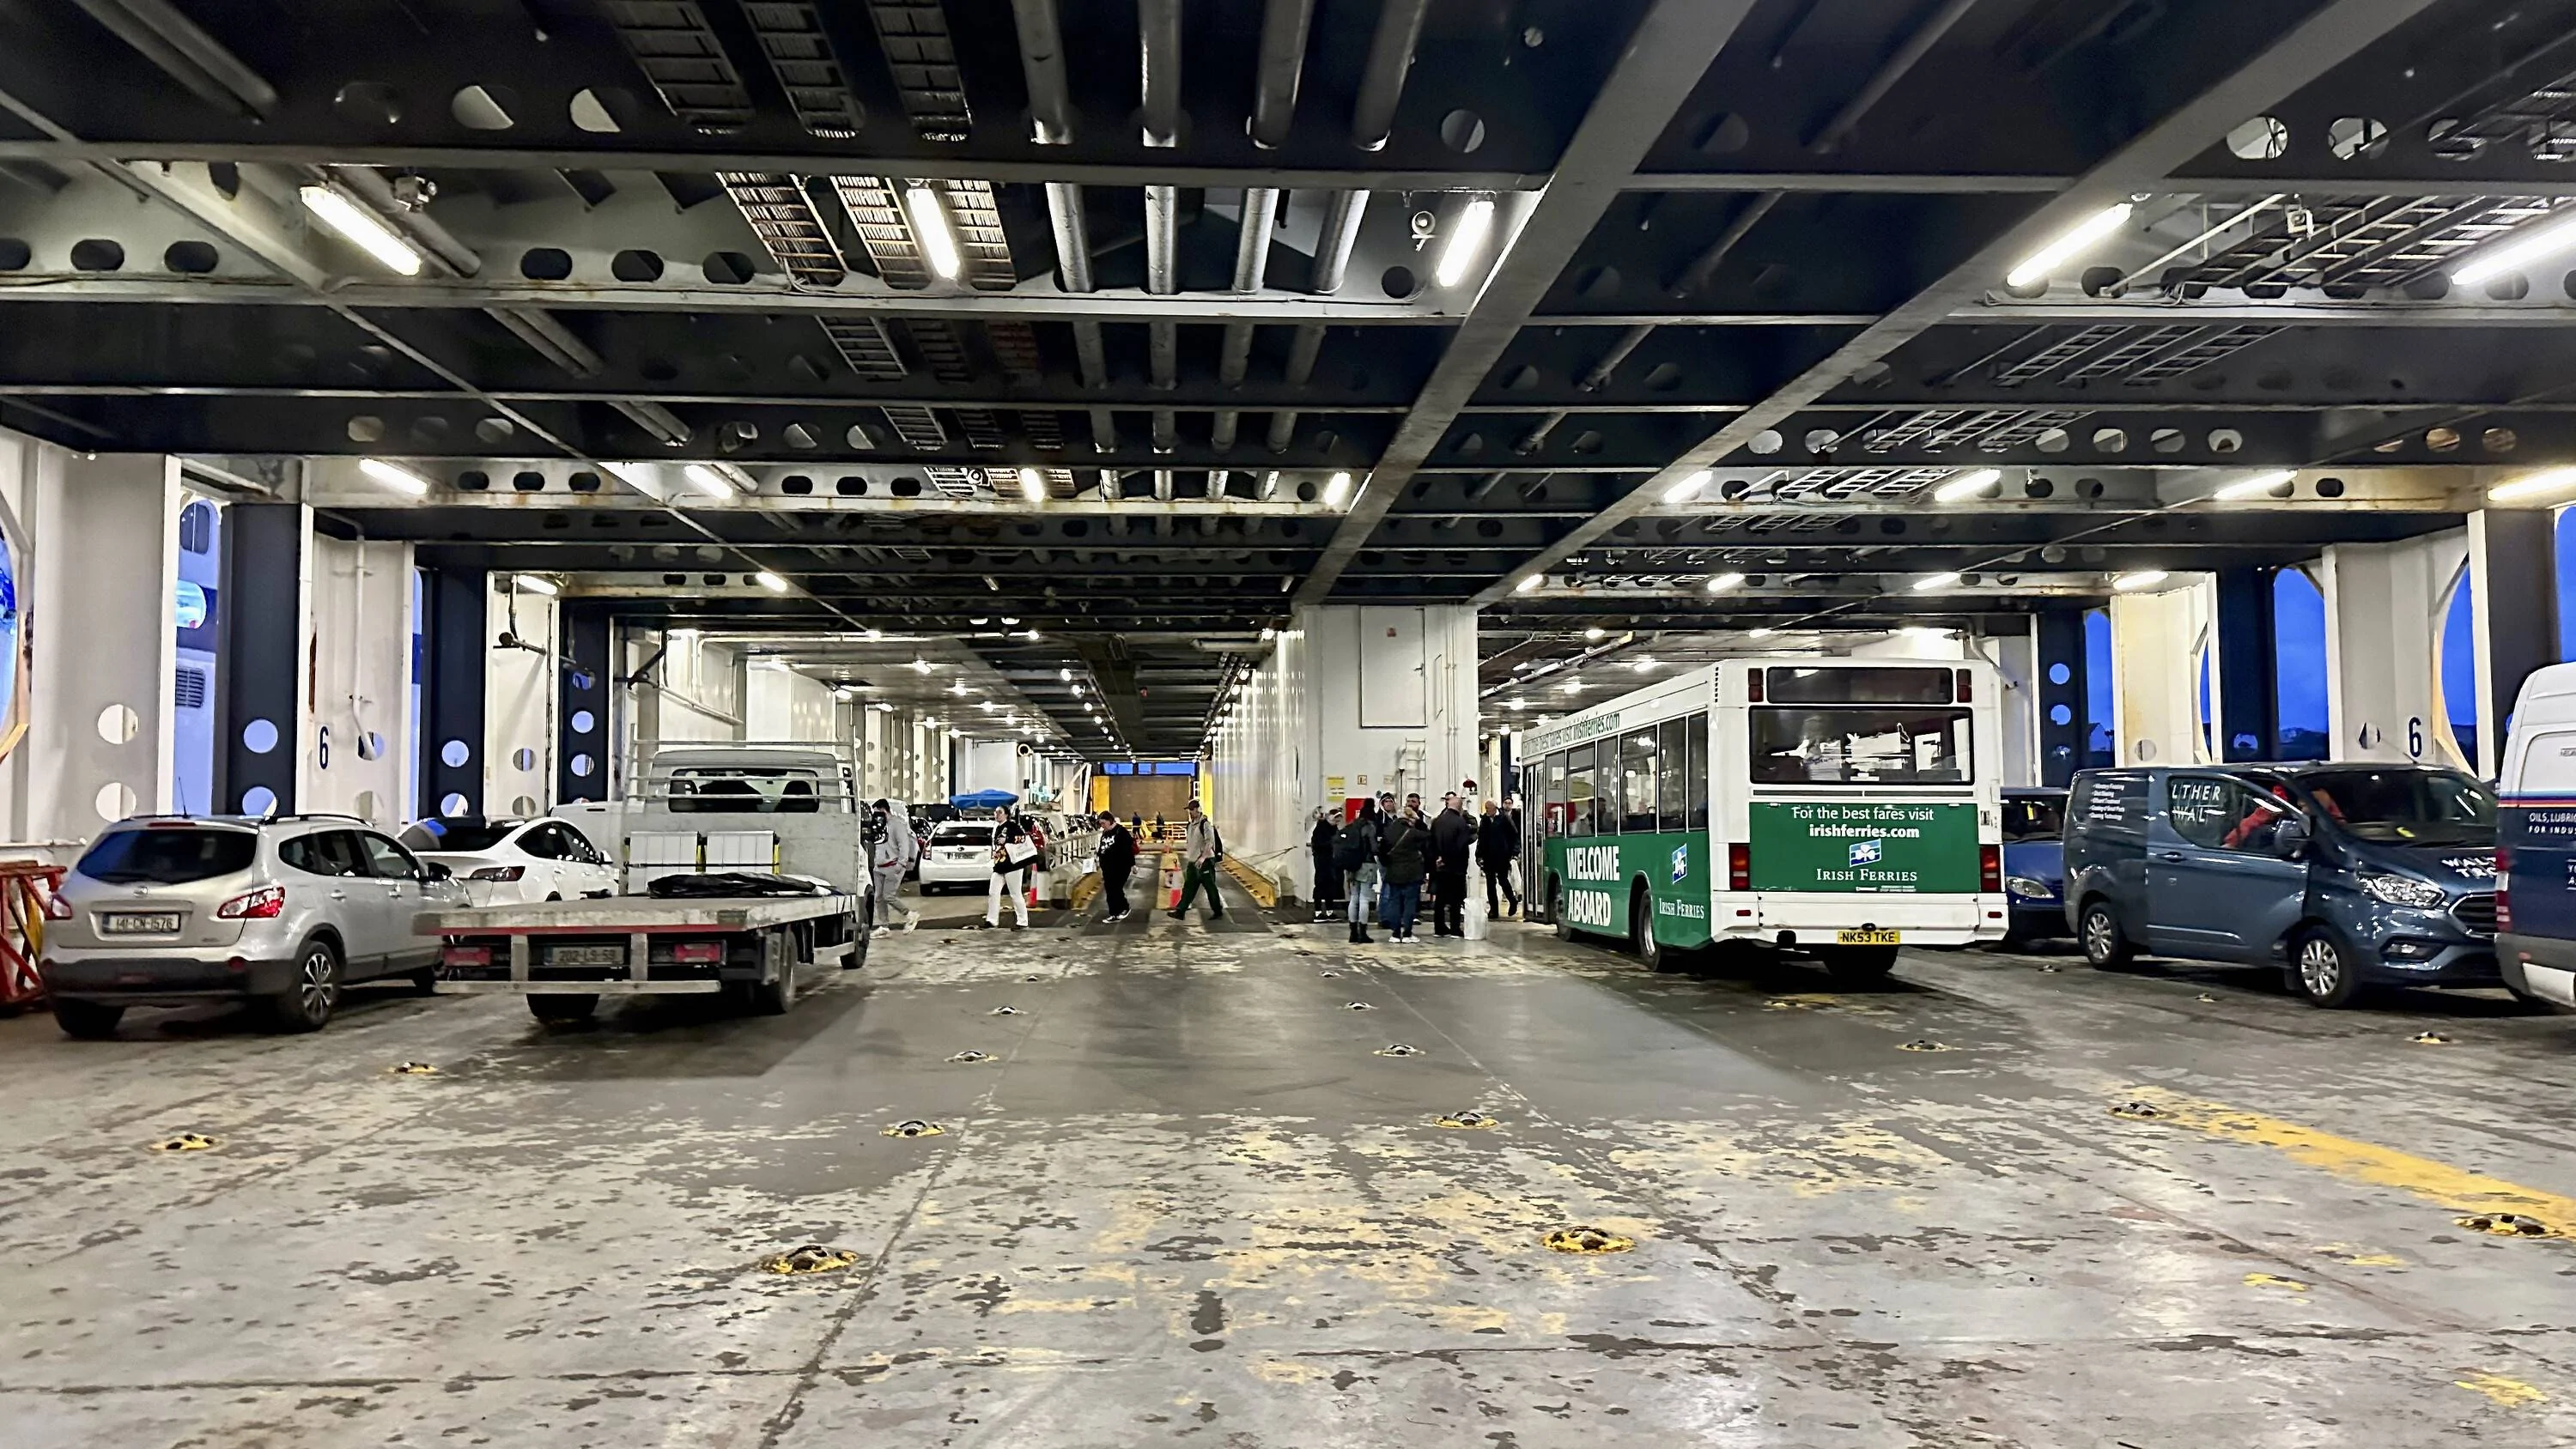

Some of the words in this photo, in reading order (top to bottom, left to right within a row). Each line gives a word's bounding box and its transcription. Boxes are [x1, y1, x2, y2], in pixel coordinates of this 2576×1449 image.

[2409, 716, 2422, 758] 6
[319, 725, 329, 770] 6
[1792, 807, 1814, 819] For
[1817, 806, 1838, 819] the
[1842, 806, 1870, 820] best
[1874, 807, 1905, 821] fares
[1908, 808, 1935, 821] visit
[1808, 823, 1920, 839] irishferries.com
[2529, 825, 2547, 834] FOR
[1566, 846, 1620, 881] WELCOME
[1816, 868, 1855, 881] IRISH
[1860, 869, 1917, 882] FERRIES
[1567, 889, 1612, 927] ABOARD
[1842, 932, 1872, 943] NK53
[1874, 931, 1895, 943] TKE
